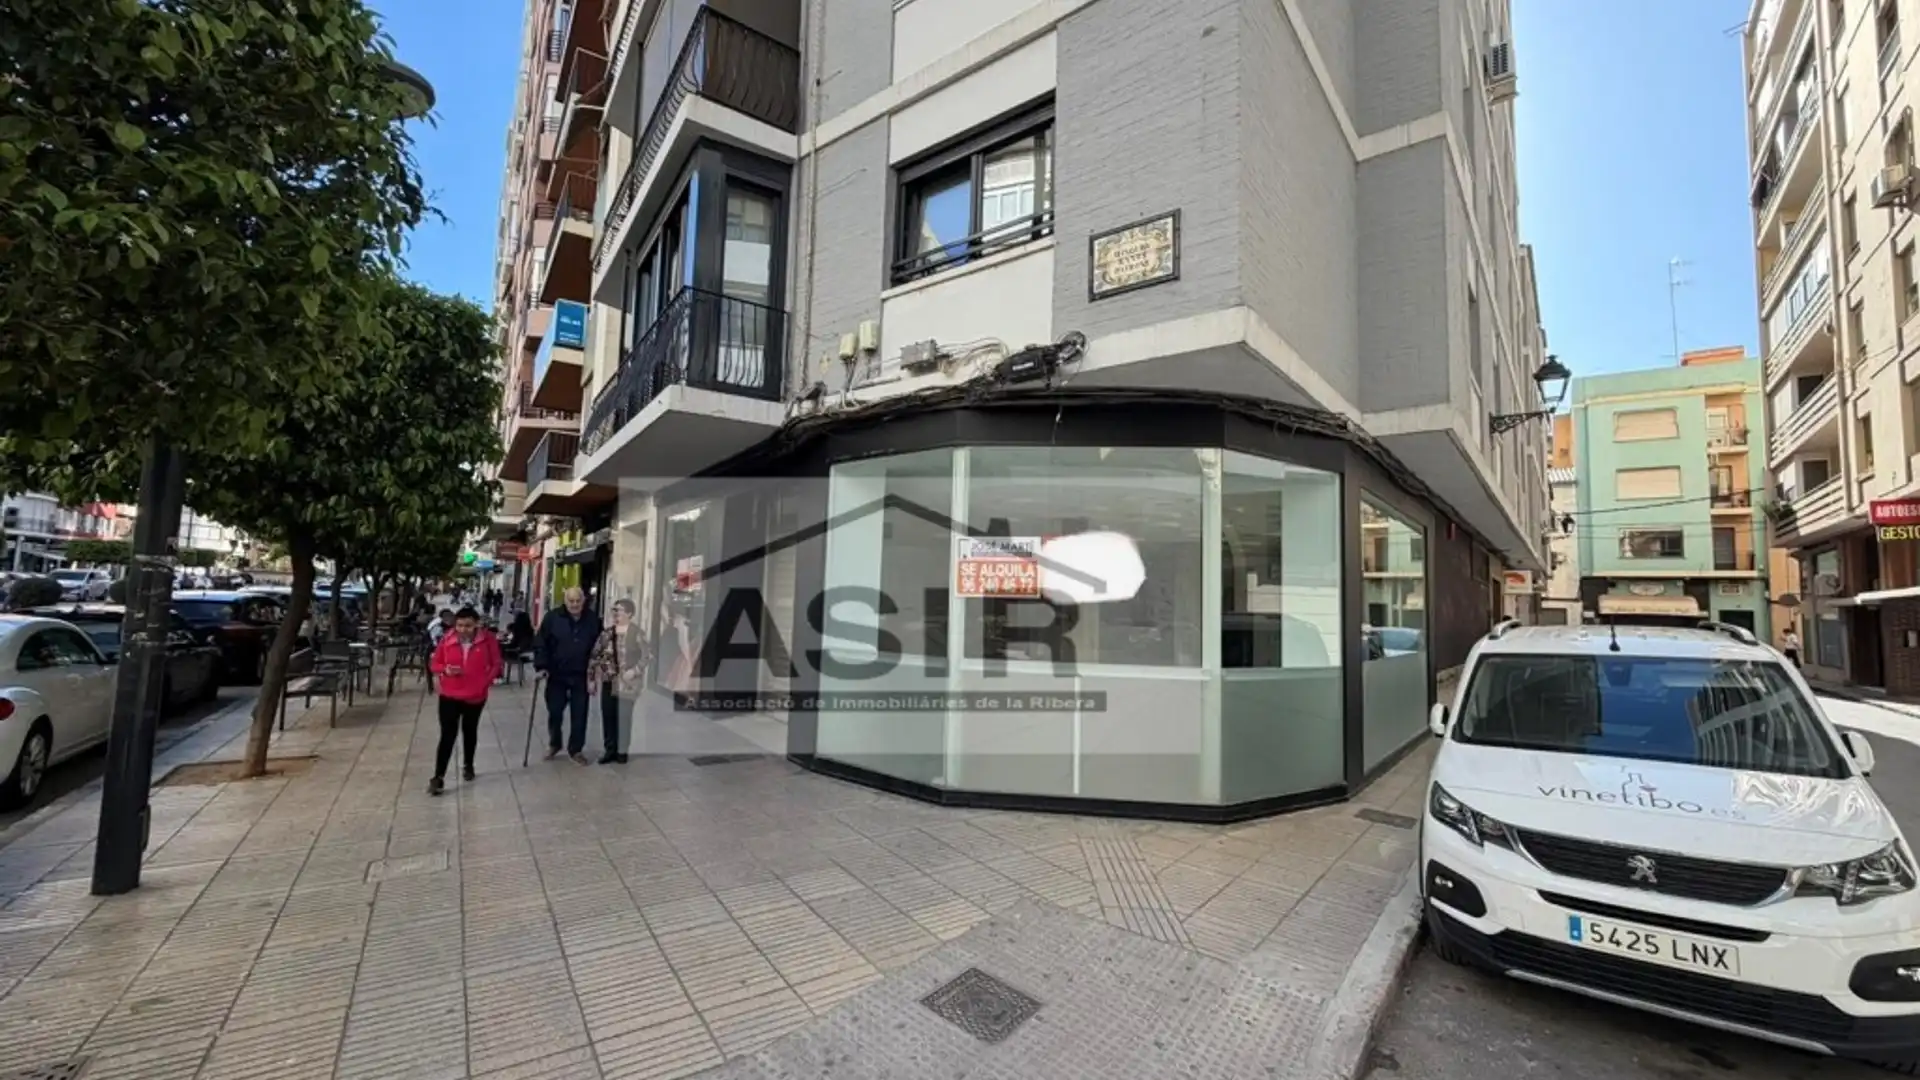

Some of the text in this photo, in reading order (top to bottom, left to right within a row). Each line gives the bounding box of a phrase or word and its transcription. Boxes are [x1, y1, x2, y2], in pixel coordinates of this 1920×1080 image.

[1875, 503, 1920, 517] AUTOES
[960, 562, 1036, 577] SE ALQUILA
[1589, 922, 1730, 970] 5425 LNX
